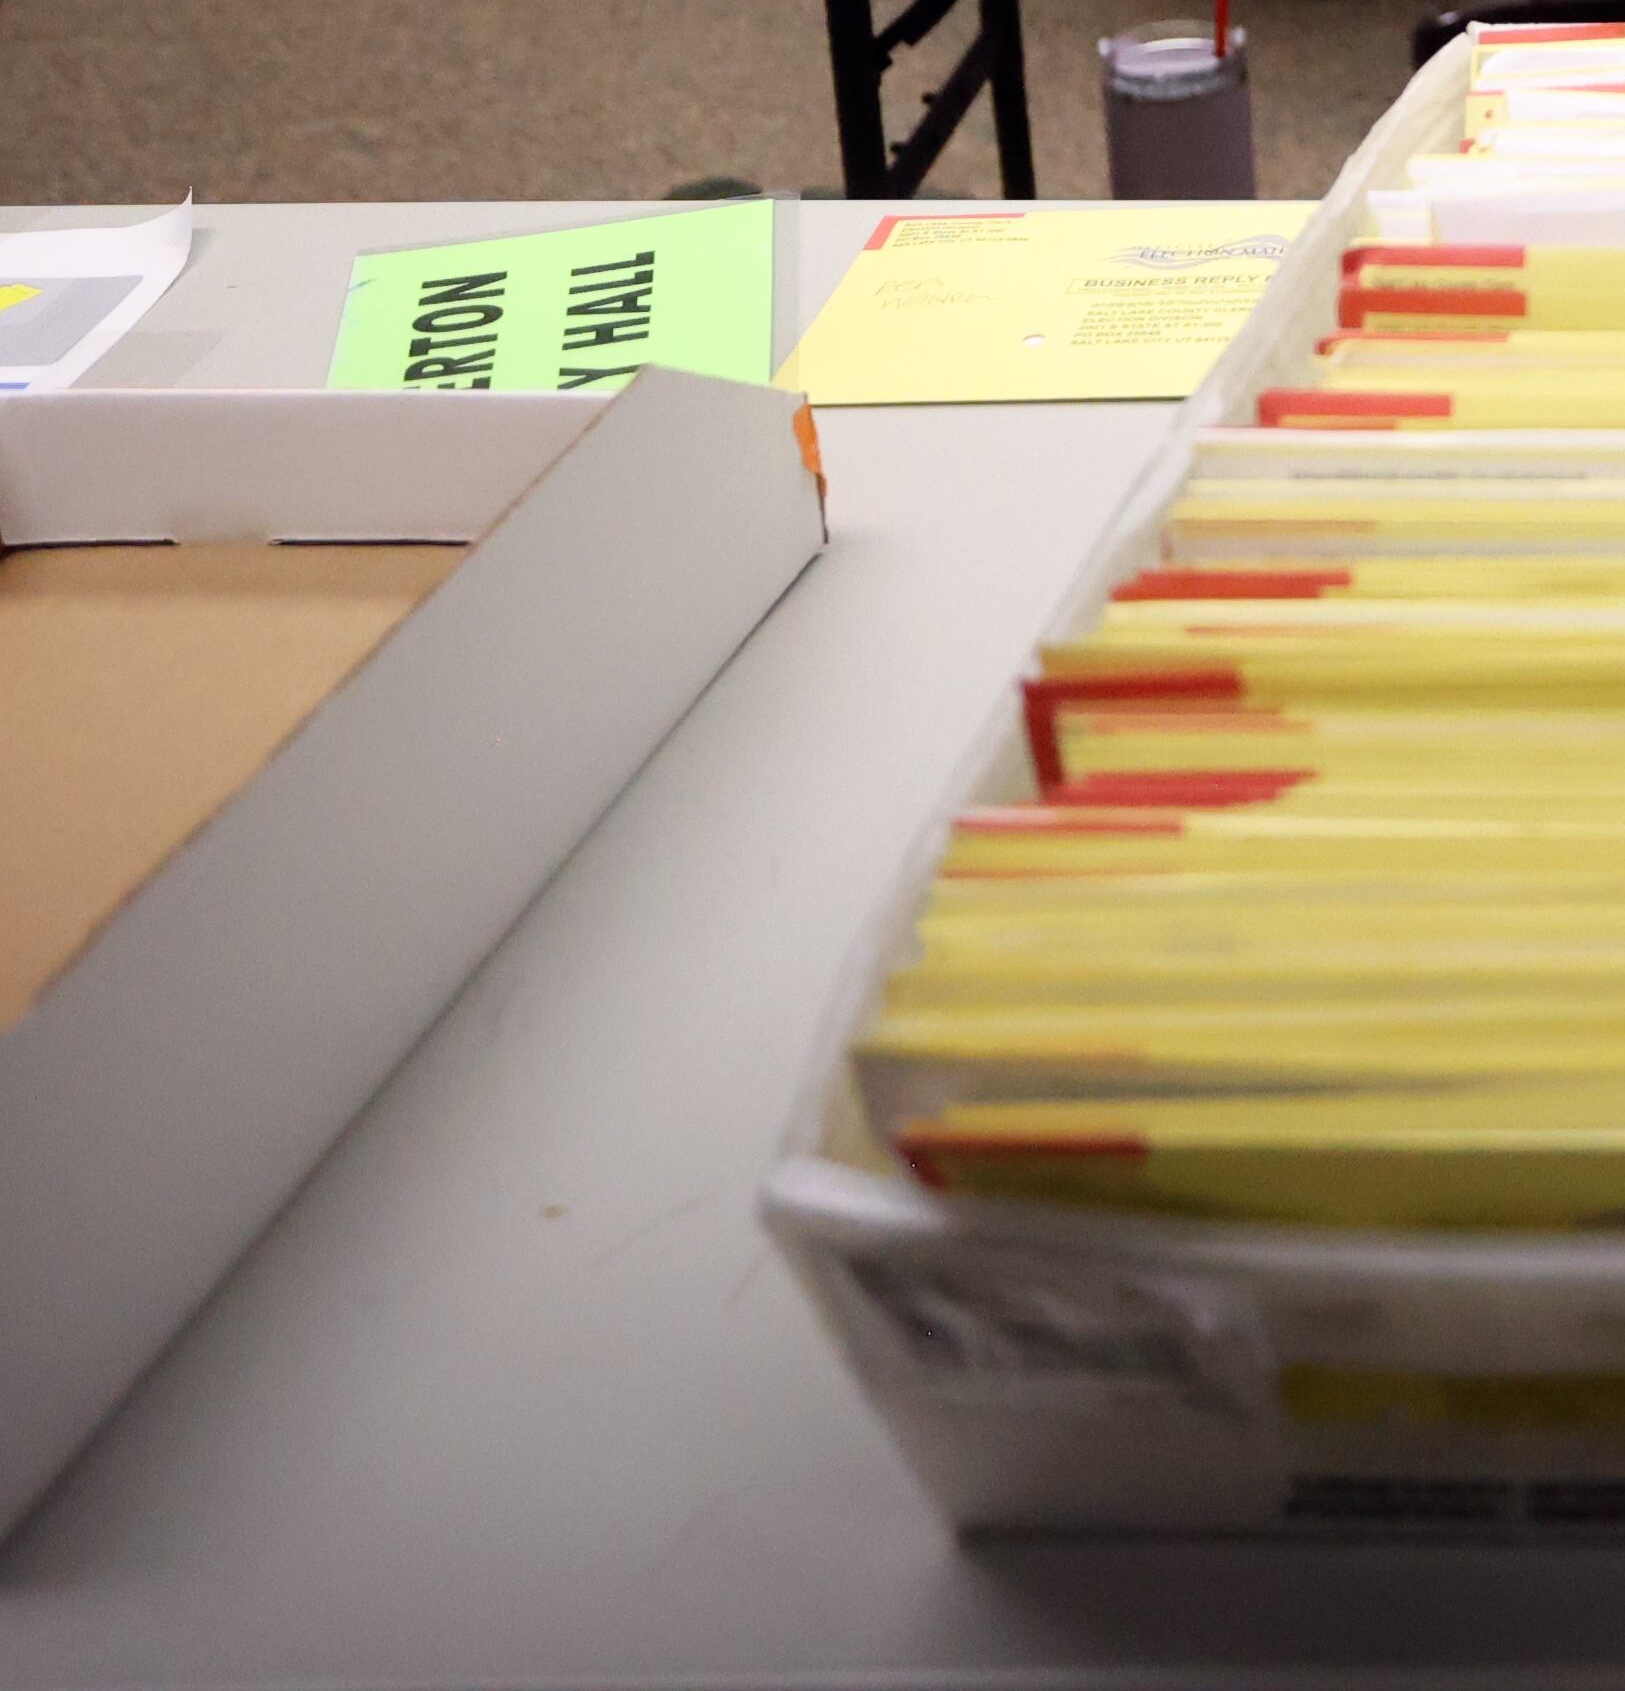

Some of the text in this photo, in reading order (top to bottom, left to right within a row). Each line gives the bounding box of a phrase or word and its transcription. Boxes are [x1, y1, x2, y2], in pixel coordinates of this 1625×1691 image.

[562, 251, 655, 350] HALL
[1083, 276, 1188, 288] BUSINESS
[1193, 274, 1259, 285] REPLY
